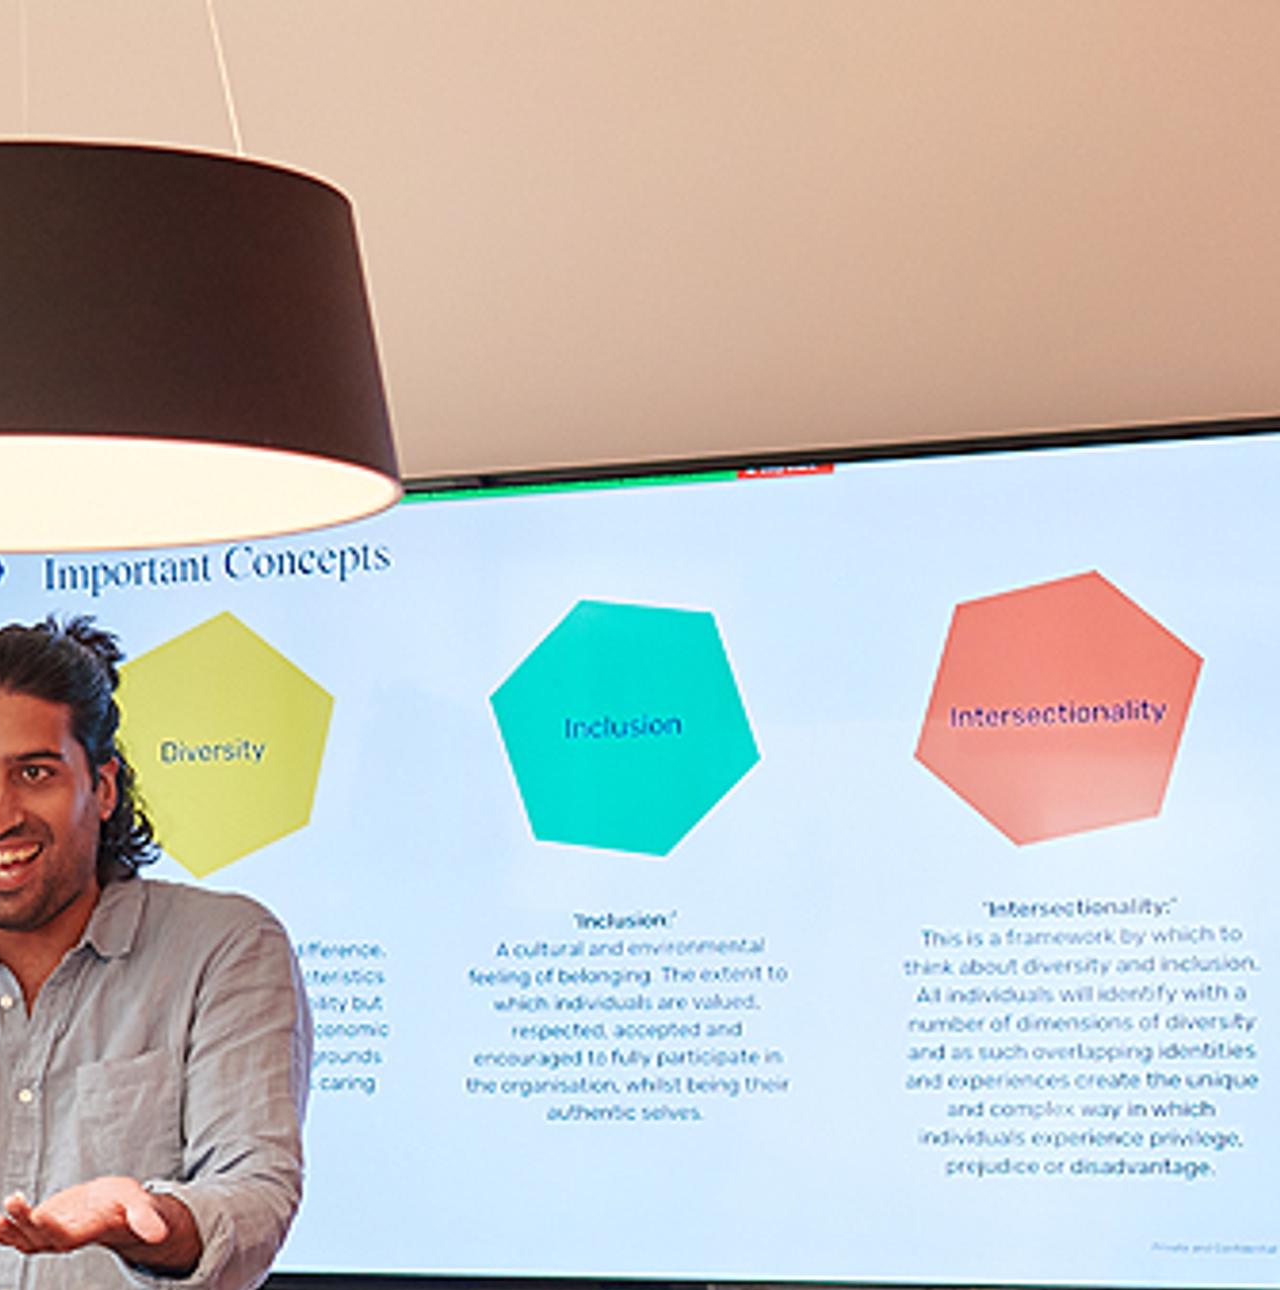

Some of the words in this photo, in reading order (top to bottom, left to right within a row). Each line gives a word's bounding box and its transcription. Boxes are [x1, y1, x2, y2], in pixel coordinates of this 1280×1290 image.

[45, 552, 211, 597] Important
[224, 542, 391, 581] Concepts
[949, 700, 1167, 730] Intersectionality
[563, 712, 683, 741] Inclusion
[161, 739, 266, 766] Diversity
[922, 928, 962, 948] This
[968, 931, 983, 949] is
[989, 932, 1002, 948] a
[1006, 927, 1114, 947] framework
[1120, 927, 1146, 949] by
[1152, 925, 1215, 945] which
[1221, 926, 1243, 943] to
[496, 942, 509, 958] A
[513, 941, 584, 960] cultural
[588, 939, 623, 958] and
[627, 937, 764, 957] environmental
[469, 968, 531, 990] feeling
[535, 967, 554, 987] of
[661, 965, 696, 983] The
[700, 965, 762, 983] extent
[767, 965, 788, 983] to
[904, 959, 952, 977] think
[960, 958, 1018, 977] about
[1023, 957, 1111, 977] diversity
[1116, 956, 1155, 975] and
[352, 996, 383, 1011] but
[493, 996, 549, 1014] which
[555, 993, 651, 1014] individuals
[657, 996, 687, 1011] are
[917, 986, 940, 1004] All
[946, 986, 1054, 1006] individuals
[1061, 985, 1095, 1003] will
[1098, 982, 1176, 1006] identify
[1181, 984, 1230, 1002] with
[1235, 985, 1247, 1002] a
[613, 1022, 700, 1041] accepted
[706, 1021, 743, 1038] and
[909, 1016, 983, 1034] number
[989, 1012, 1011, 1033] of
[1017, 1015, 1133, 1033] dimensions
[1139, 1012, 1160, 1033] of
[1165, 1012, 1257, 1034] diversity
[474, 1049, 581, 1071] encouraged
[588, 1049, 607, 1067] to
[611, 1047, 651, 1068] fully
[657, 1048, 761, 1069] participate
[765, 1050, 783, 1064] in
[907, 1044, 946, 1062] and
[951, 1046, 972, 1062] as
[978, 1044, 1028, 1062] such
[1032, 1042, 1152, 1066] overlapping
[1158, 1042, 1256, 1060] identities
[320, 1075, 377, 1096] caring
[467, 1077, 496, 1095] the
[626, 1076, 682, 1094] whilst
[688, 1076, 739, 1099] being
[745, 1076, 791, 1094] their
[905, 1073, 942, 1090] and
[948, 1073, 1069, 1093] experiences
[1074, 1071, 1141, 1090] create
[1147, 1071, 1181, 1090] the
[1186, 1073, 1259, 1092] unique
[546, 1104, 635, 1122] authentic
[947, 1101, 984, 1118] and
[989, 1100, 1074, 1121] complex
[1081, 1103, 1121, 1121] way
[1127, 1103, 1147, 1117] in
[1152, 1100, 1216, 1119] which
[919, 1129, 1025, 1147] individuals
[1031, 1128, 1144, 1150] experience
[945, 1157, 1038, 1179] prejudice
[1043, 1160, 1063, 1176] or
